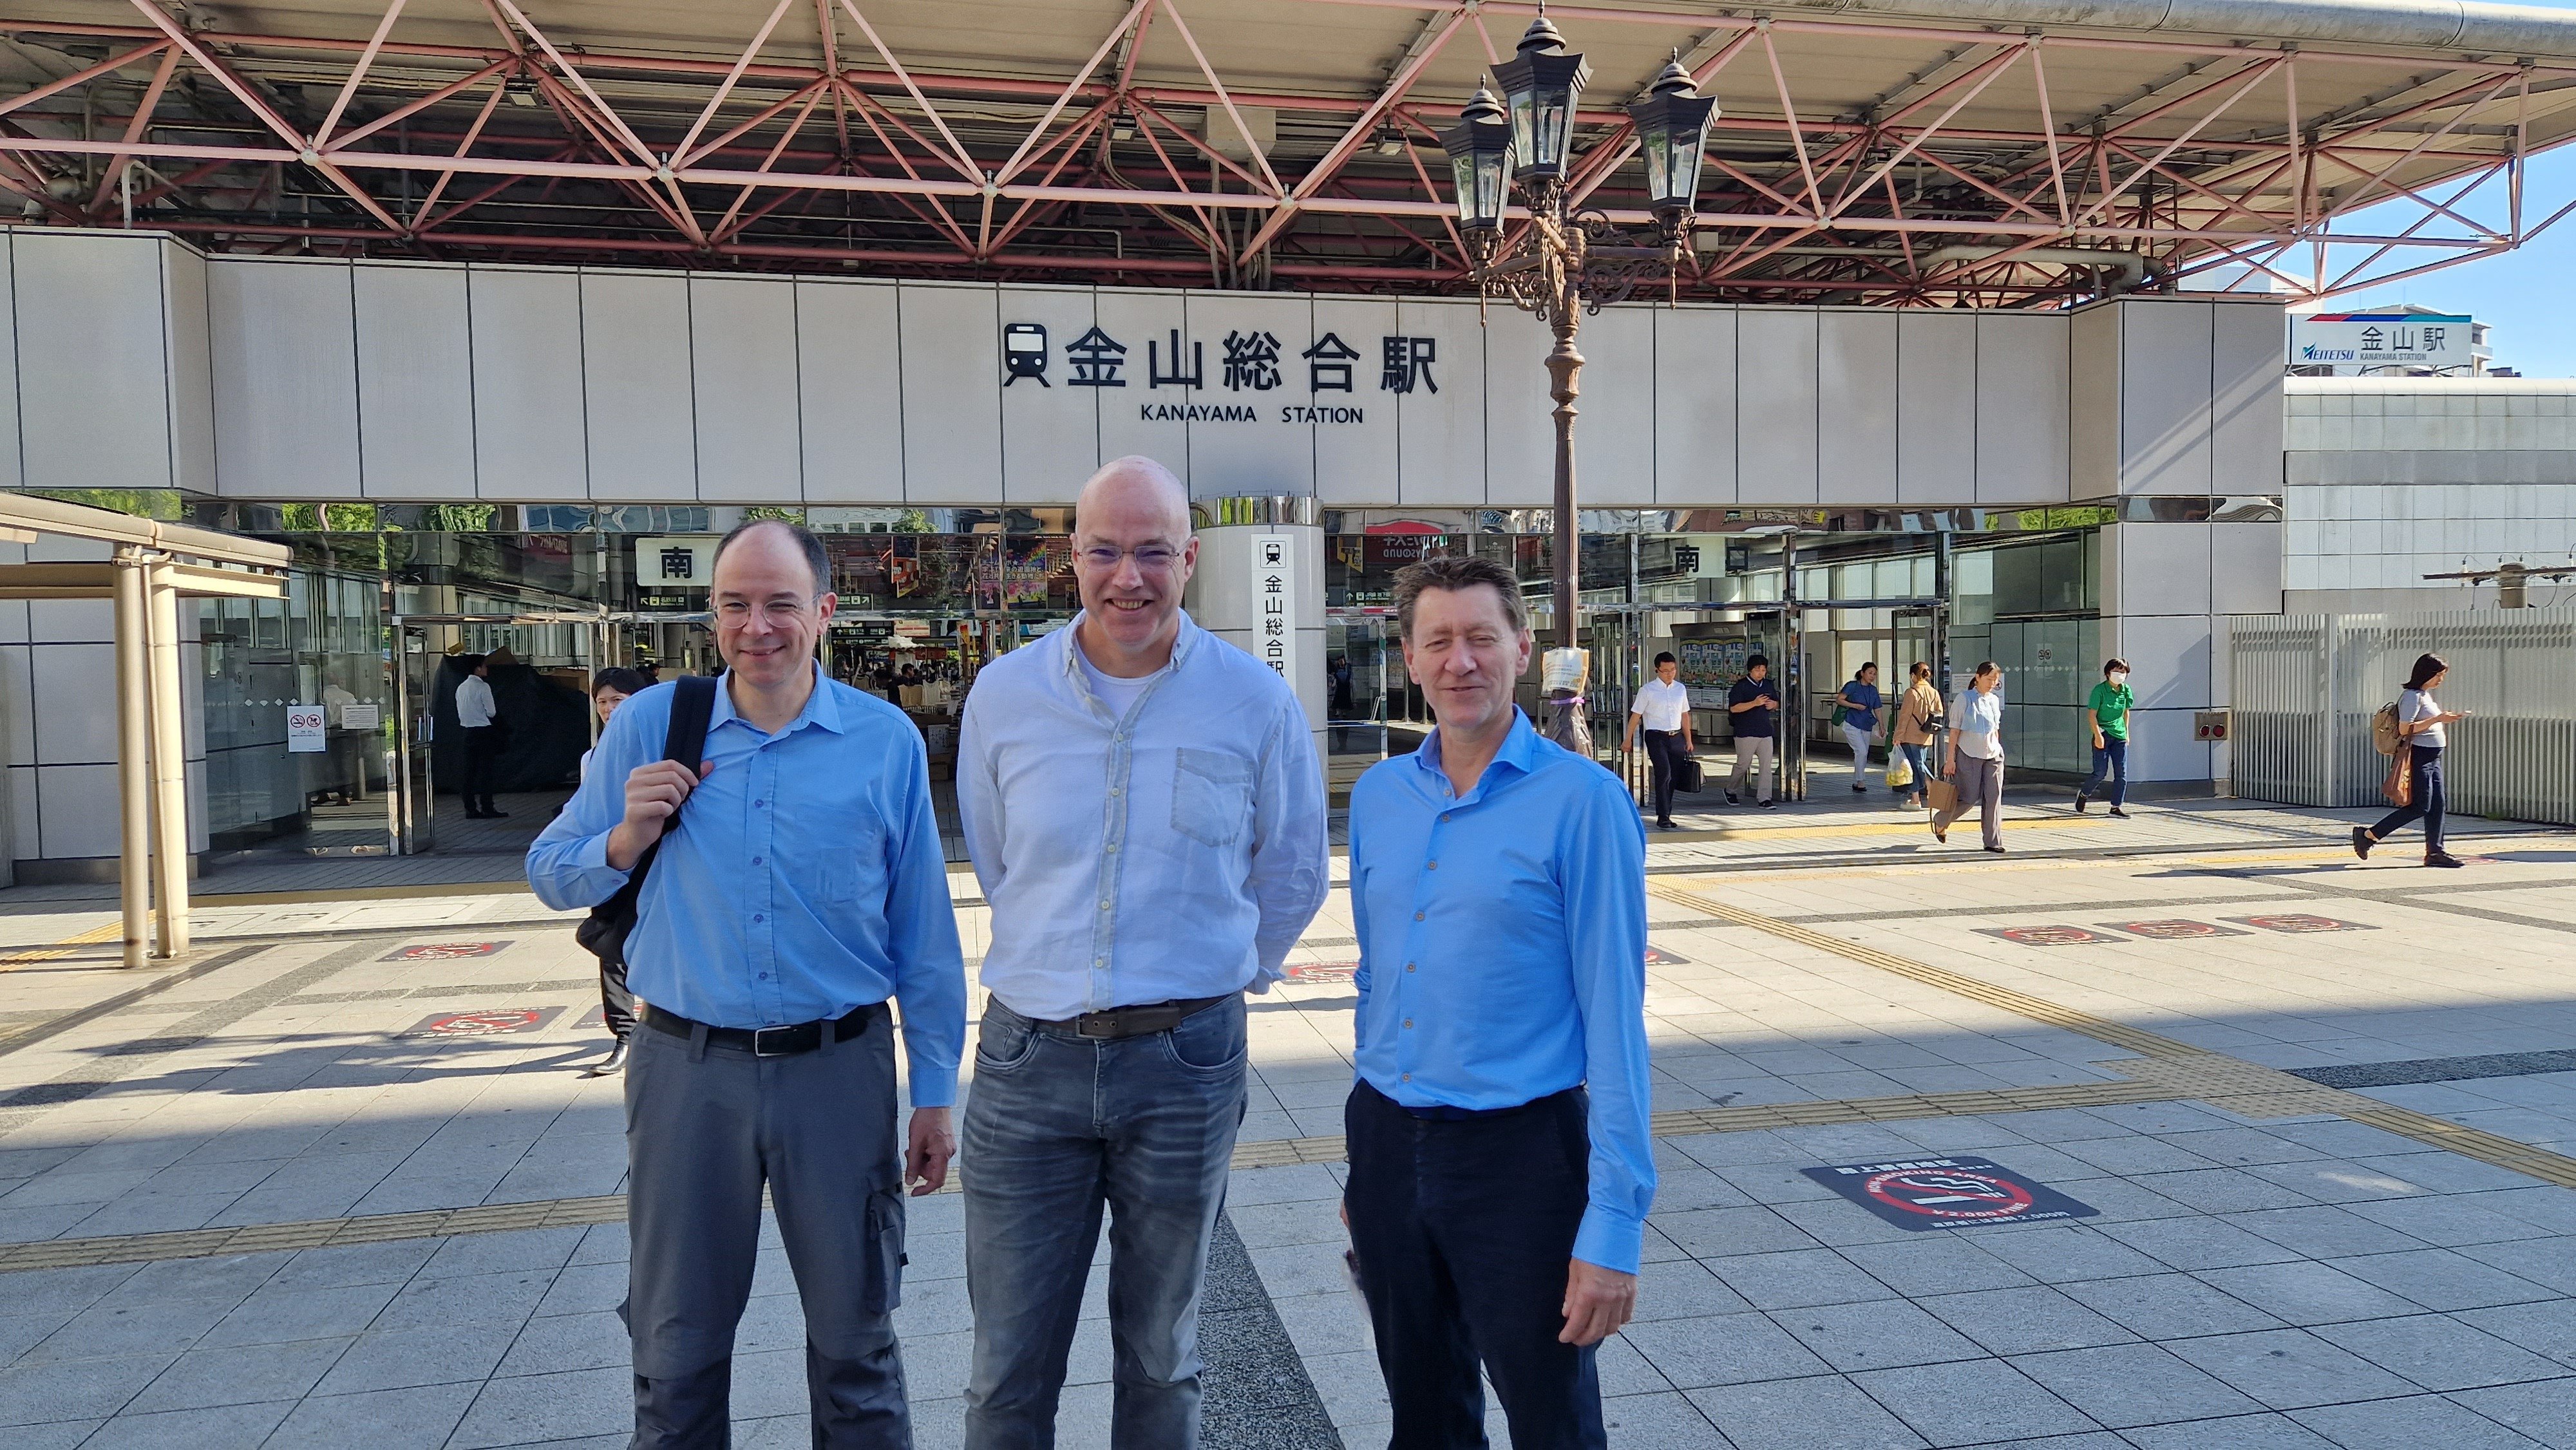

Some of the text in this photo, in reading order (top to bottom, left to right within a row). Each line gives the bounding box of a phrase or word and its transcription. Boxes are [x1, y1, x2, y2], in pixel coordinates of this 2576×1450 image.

[2361, 326, 2446, 352] 金山駅
[1065, 326, 1439, 395] 金山総合駅
[2300, 341, 2354, 360] MEITETSU
[2360, 352, 2427, 361] KANAYAMA STATION
[1141, 404, 1363, 424] KANAYAMA STATION
[659, 546, 693, 579] 南
[1868, 1169, 1998, 1193] NON-SMOKING AREA
[1999, 1202, 2029, 1215] FINE
